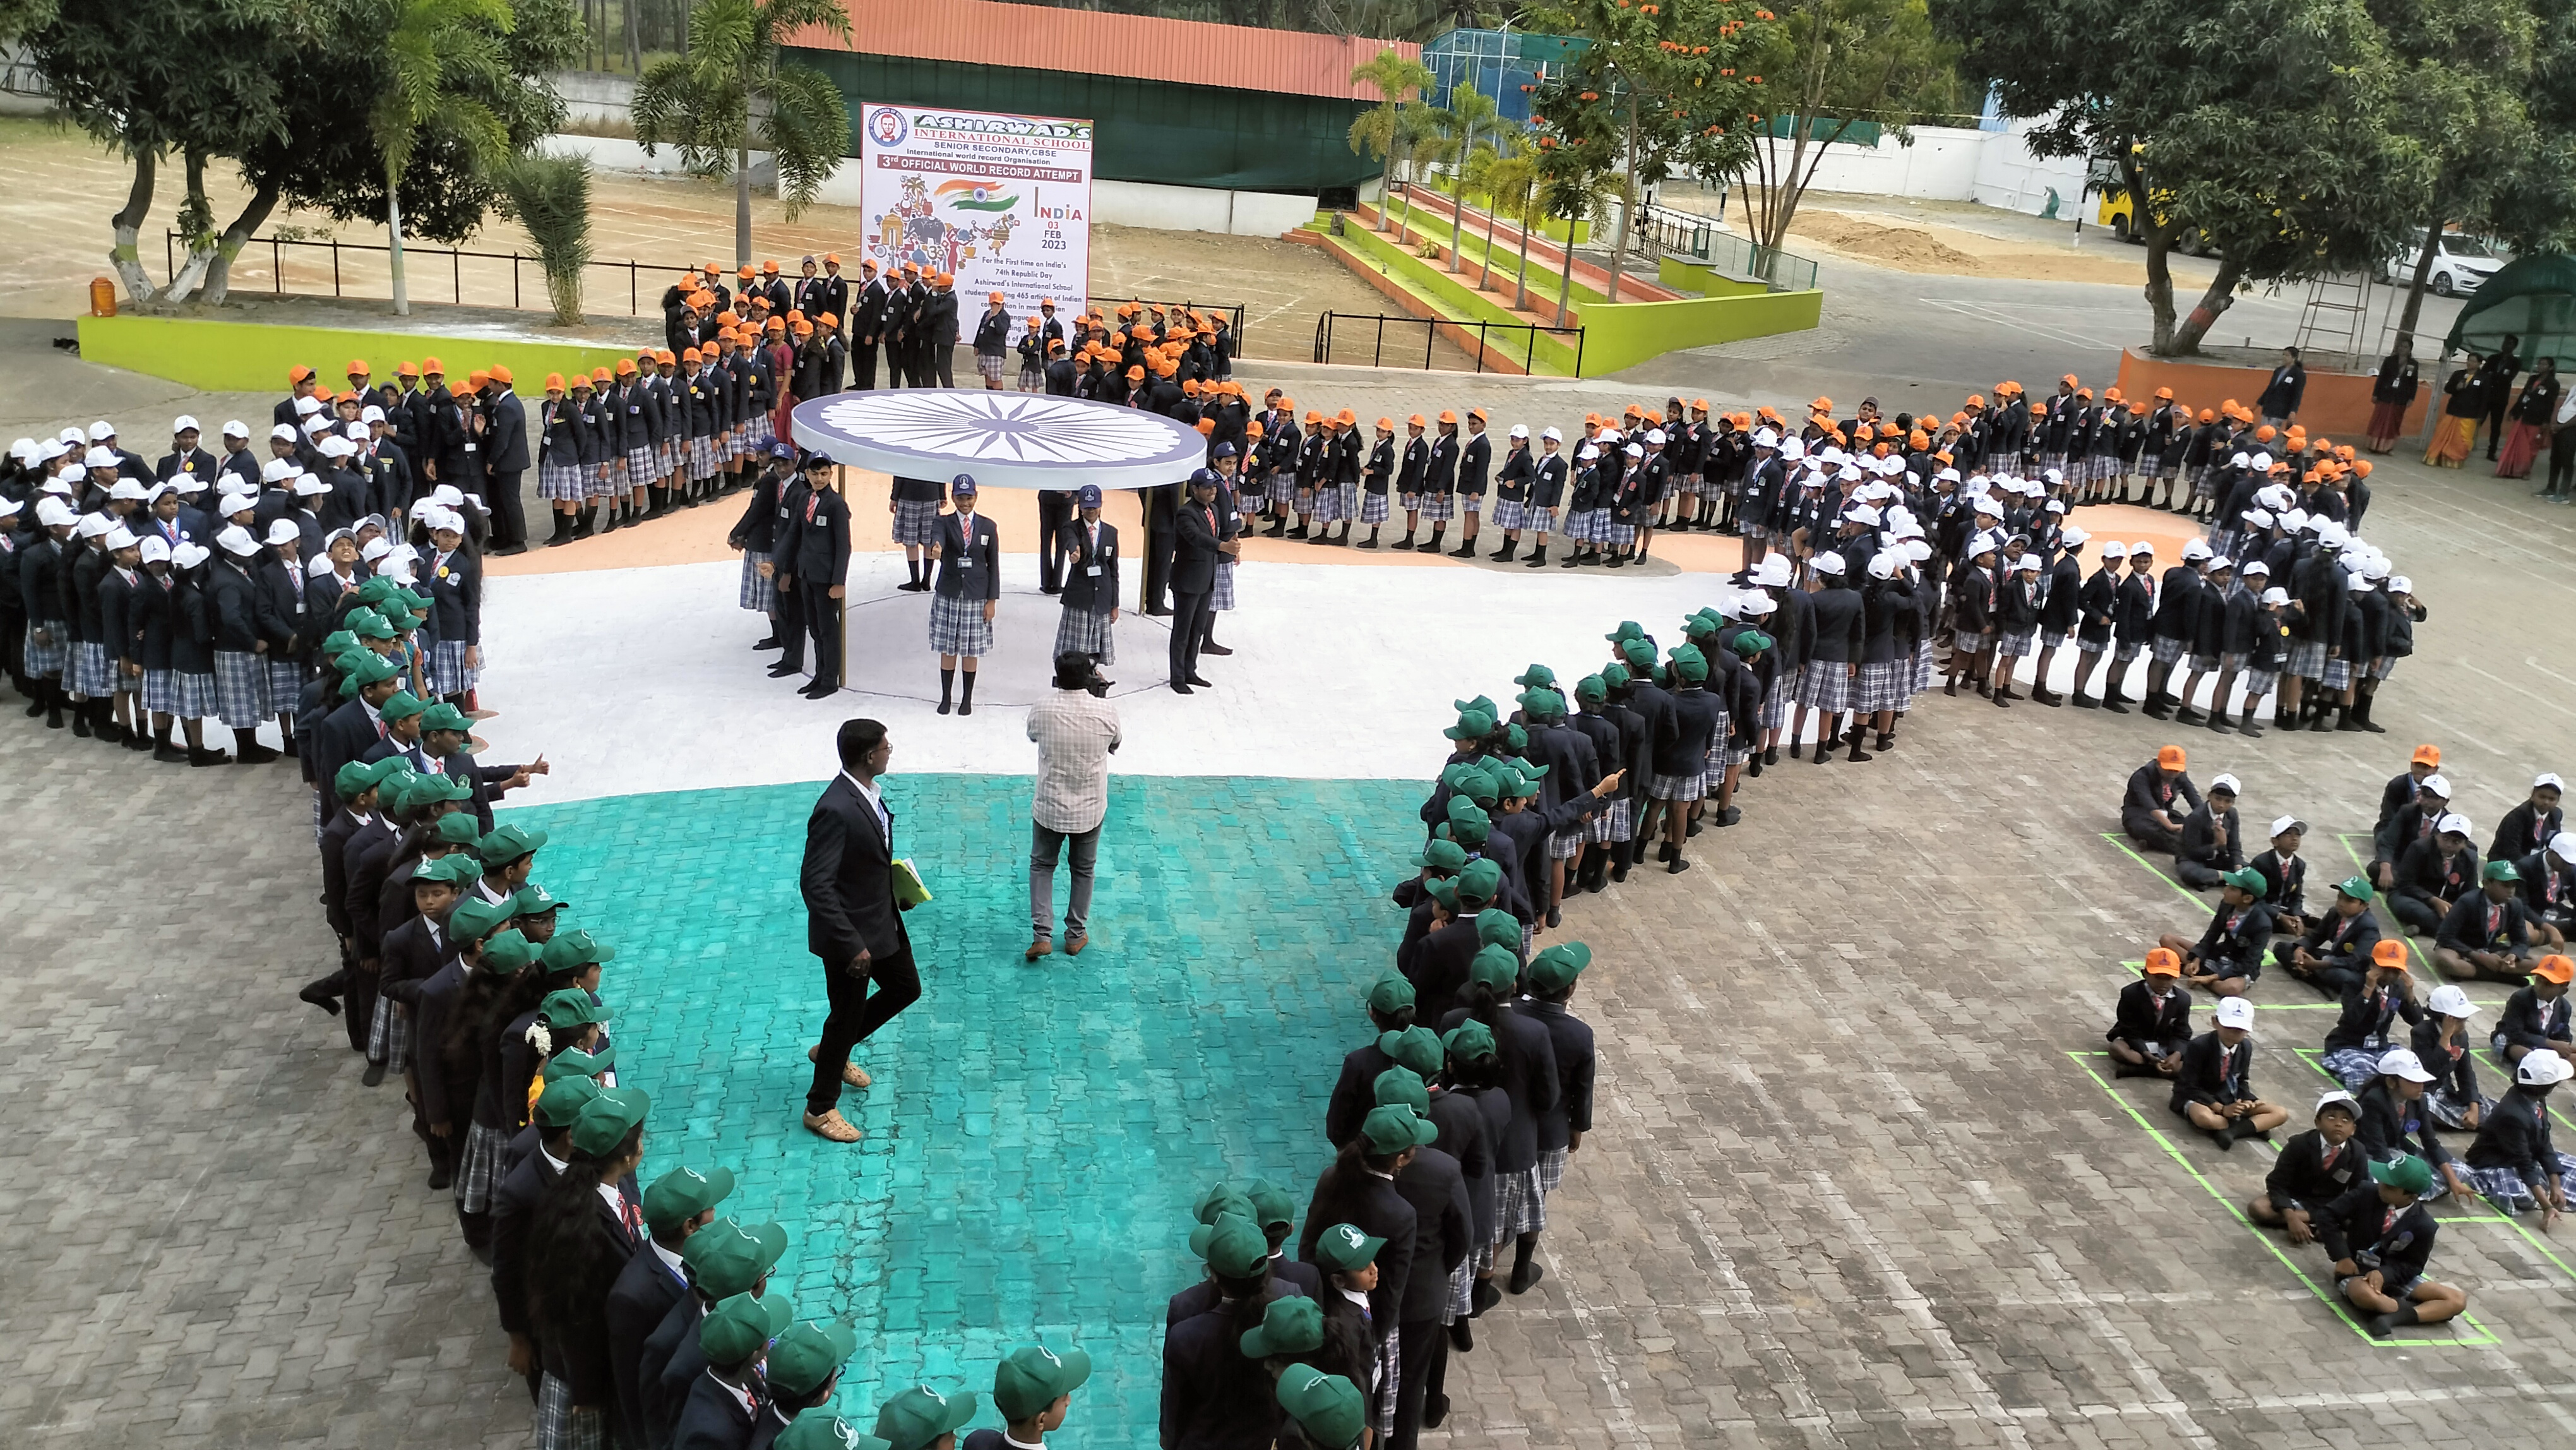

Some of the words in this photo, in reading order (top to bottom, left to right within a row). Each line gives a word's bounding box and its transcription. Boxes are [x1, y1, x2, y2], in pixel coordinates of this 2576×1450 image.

[915, 115, 1091, 139] ASHIRWAD'S
[914, 128, 1029, 145] INTERNATIONAL
[1034, 138, 1090, 150] SCHOOL
[934, 141, 969, 150] SENIOR
[907, 148, 953, 158] International
[1004, 156, 1051, 165] Organisation
[883, 156, 898, 167] 3rd
[901, 159, 947, 171] OFFICIAL
[950, 162, 986, 174] WORLD
[989, 165, 1031, 177] RECORD
[1033, 169, 1078, 181] ATTEMPT
[1048, 221, 1059, 229] 03
[1044, 230, 1061, 239] FEB
[1042, 239, 1066, 250] 2023
[1011, 270, 1038, 279] Republic
[1040, 272, 1052, 280] Day
[974, 279, 1010, 287] Ashirwad's
[1011, 280, 1051, 289] International
